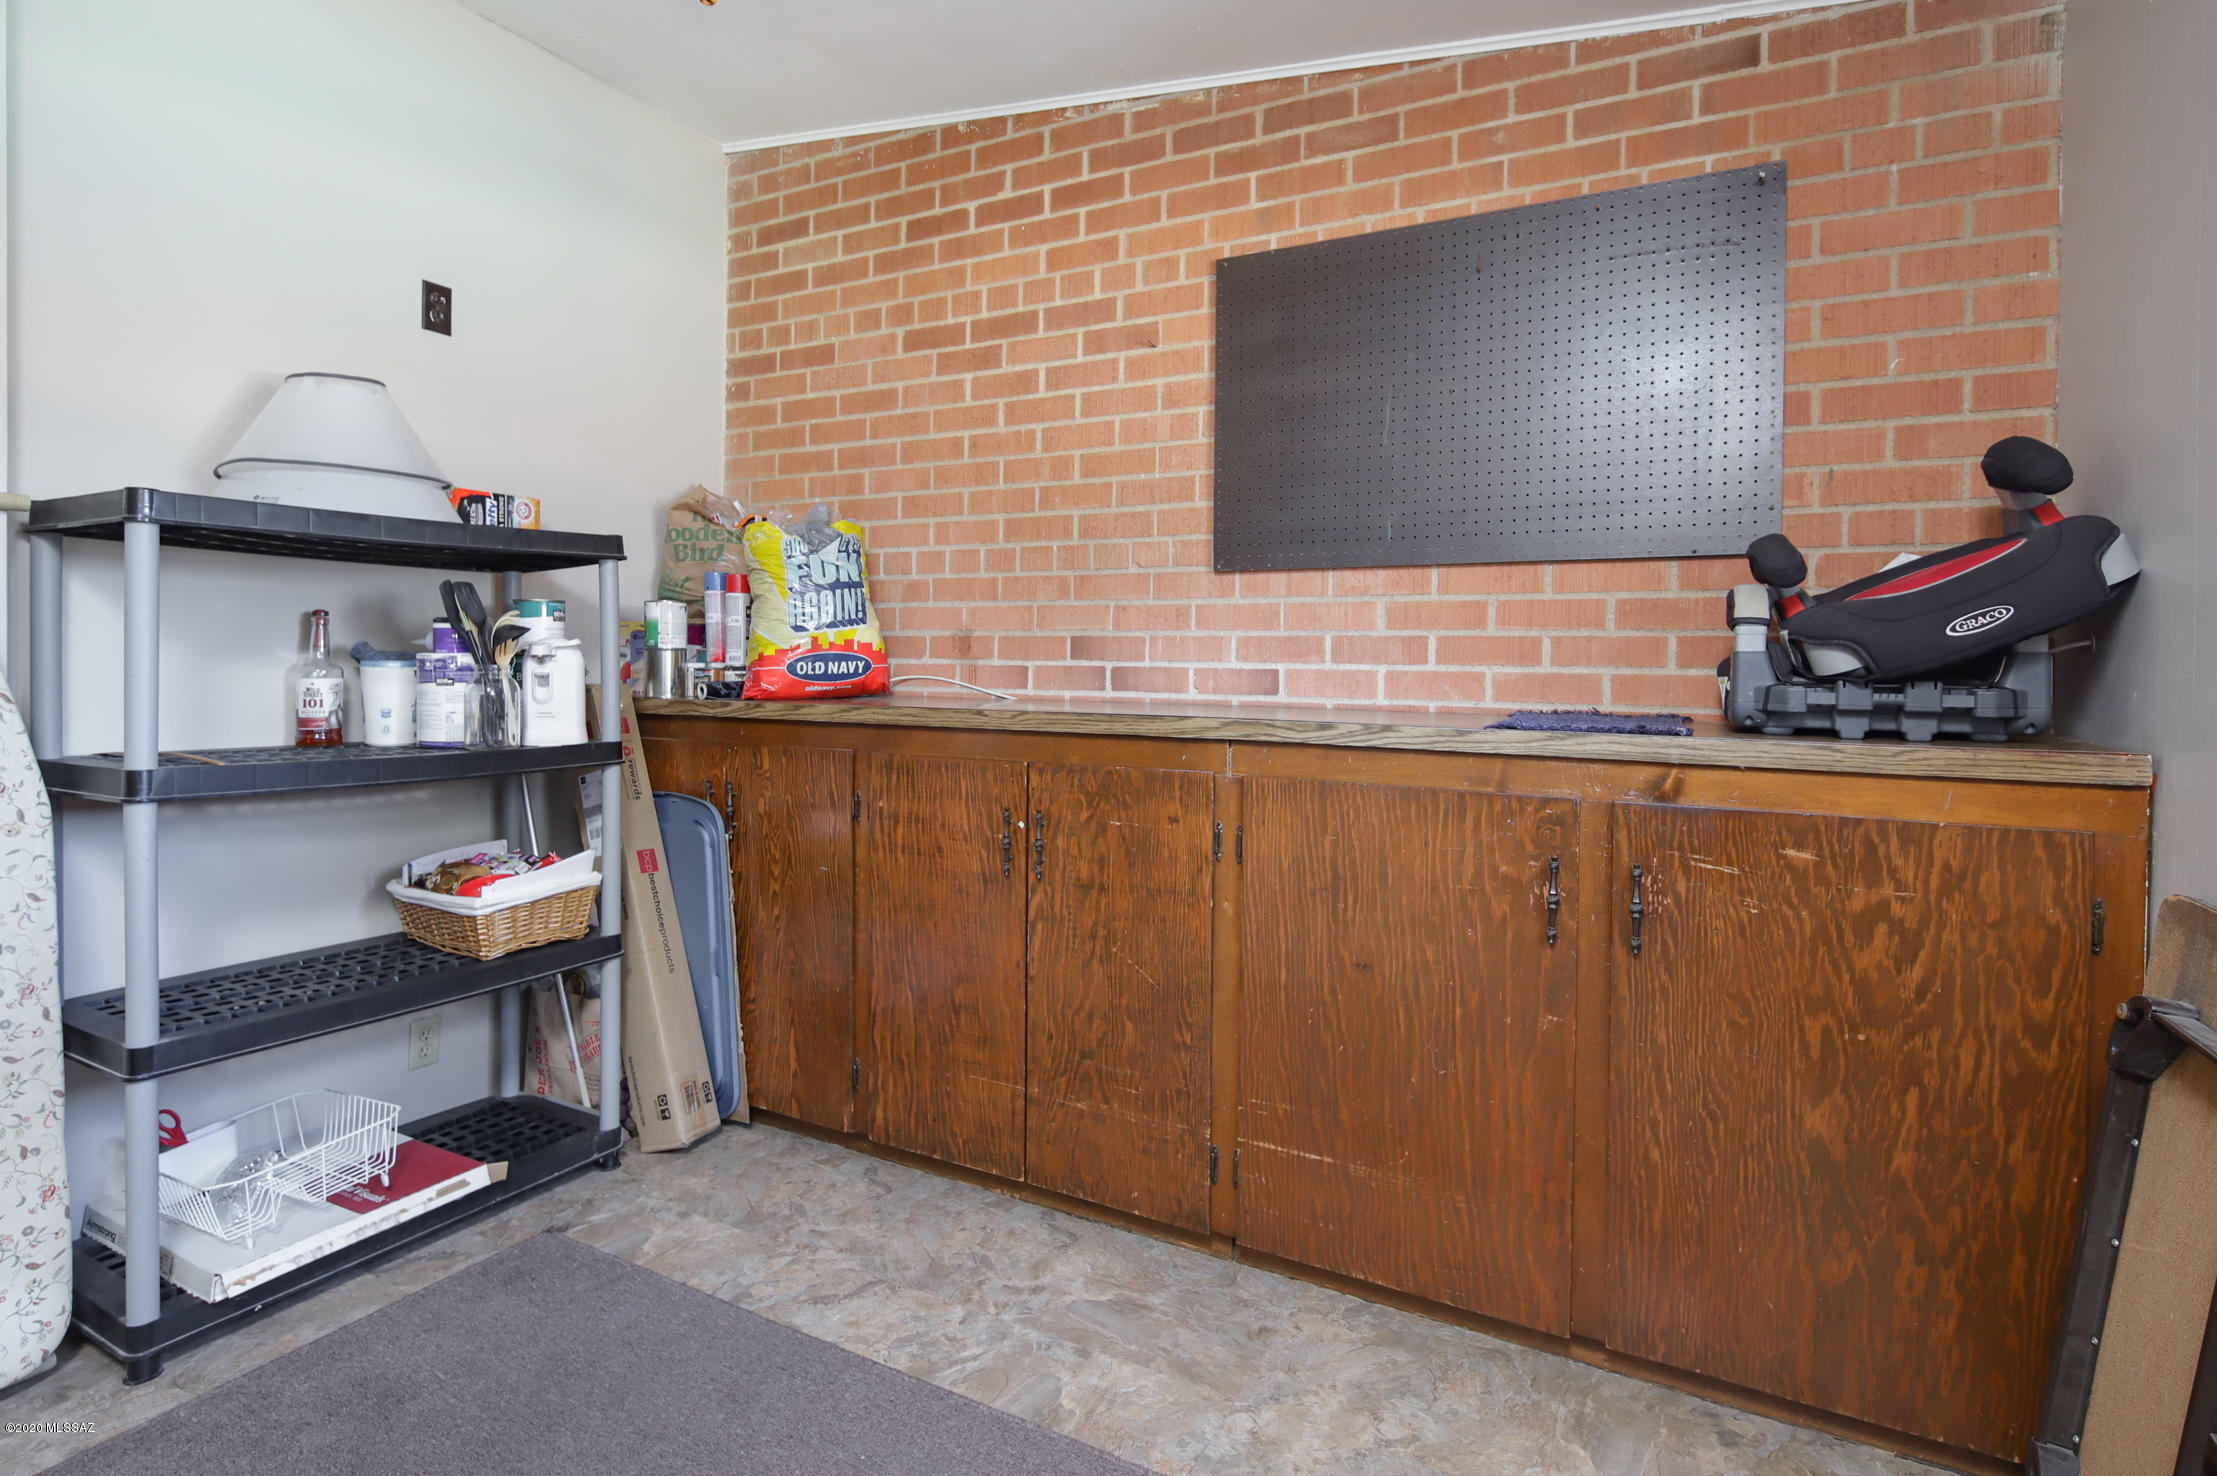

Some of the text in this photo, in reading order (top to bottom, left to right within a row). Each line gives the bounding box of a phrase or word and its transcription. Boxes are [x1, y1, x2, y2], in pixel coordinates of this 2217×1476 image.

[488, 499, 497, 526] efty
[664, 523, 743, 544] ooden
[673, 542, 725, 562] Bird
[787, 552, 862, 589] FUN
[788, 587, 864, 628] AGAIN!
[1955, 608, 2006, 632] GRACO
[796, 660, 865, 675] OLD NAVY
[303, 699, 324, 709] 101
[629, 759, 643, 801] rewards
[643, 850, 676, 975] bcp bestchoiceproducts
[86, 1218, 117, 1243] Armstrong
